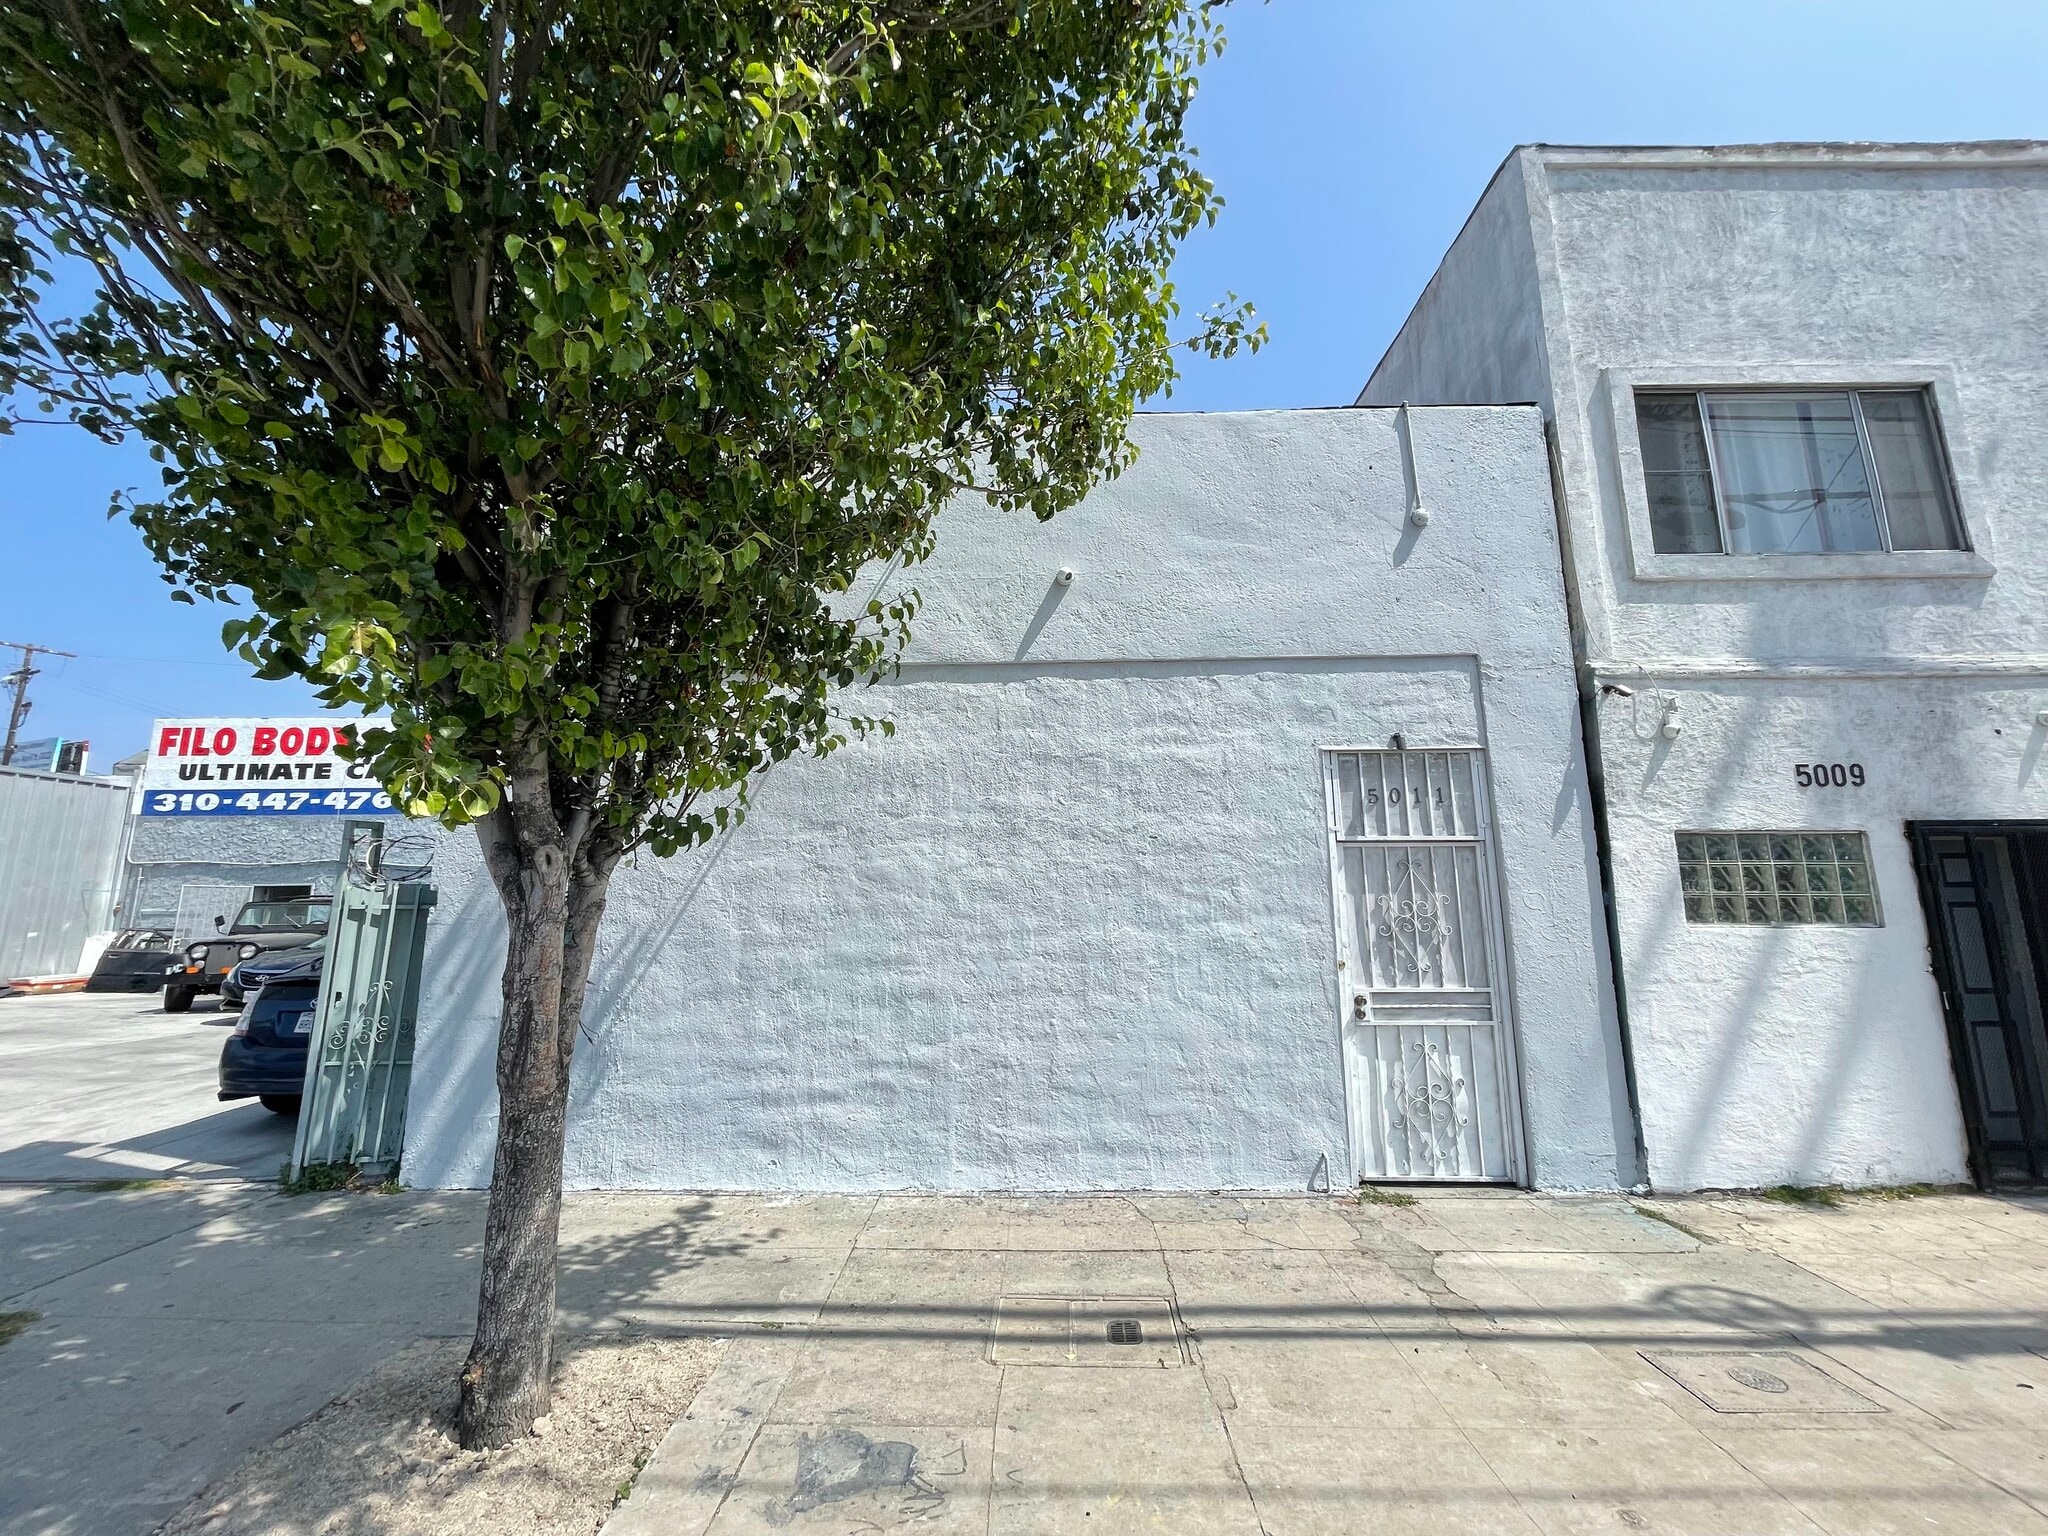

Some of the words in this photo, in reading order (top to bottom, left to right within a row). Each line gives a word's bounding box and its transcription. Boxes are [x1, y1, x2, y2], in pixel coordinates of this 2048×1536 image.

[158, 727, 237, 756] FILO
[179, 763, 332, 781] ULTIMATE
[1795, 763, 1866, 787] 5009
[152, 791, 411, 812] 310-447-476
[1367, 787, 1444, 804] 5011
